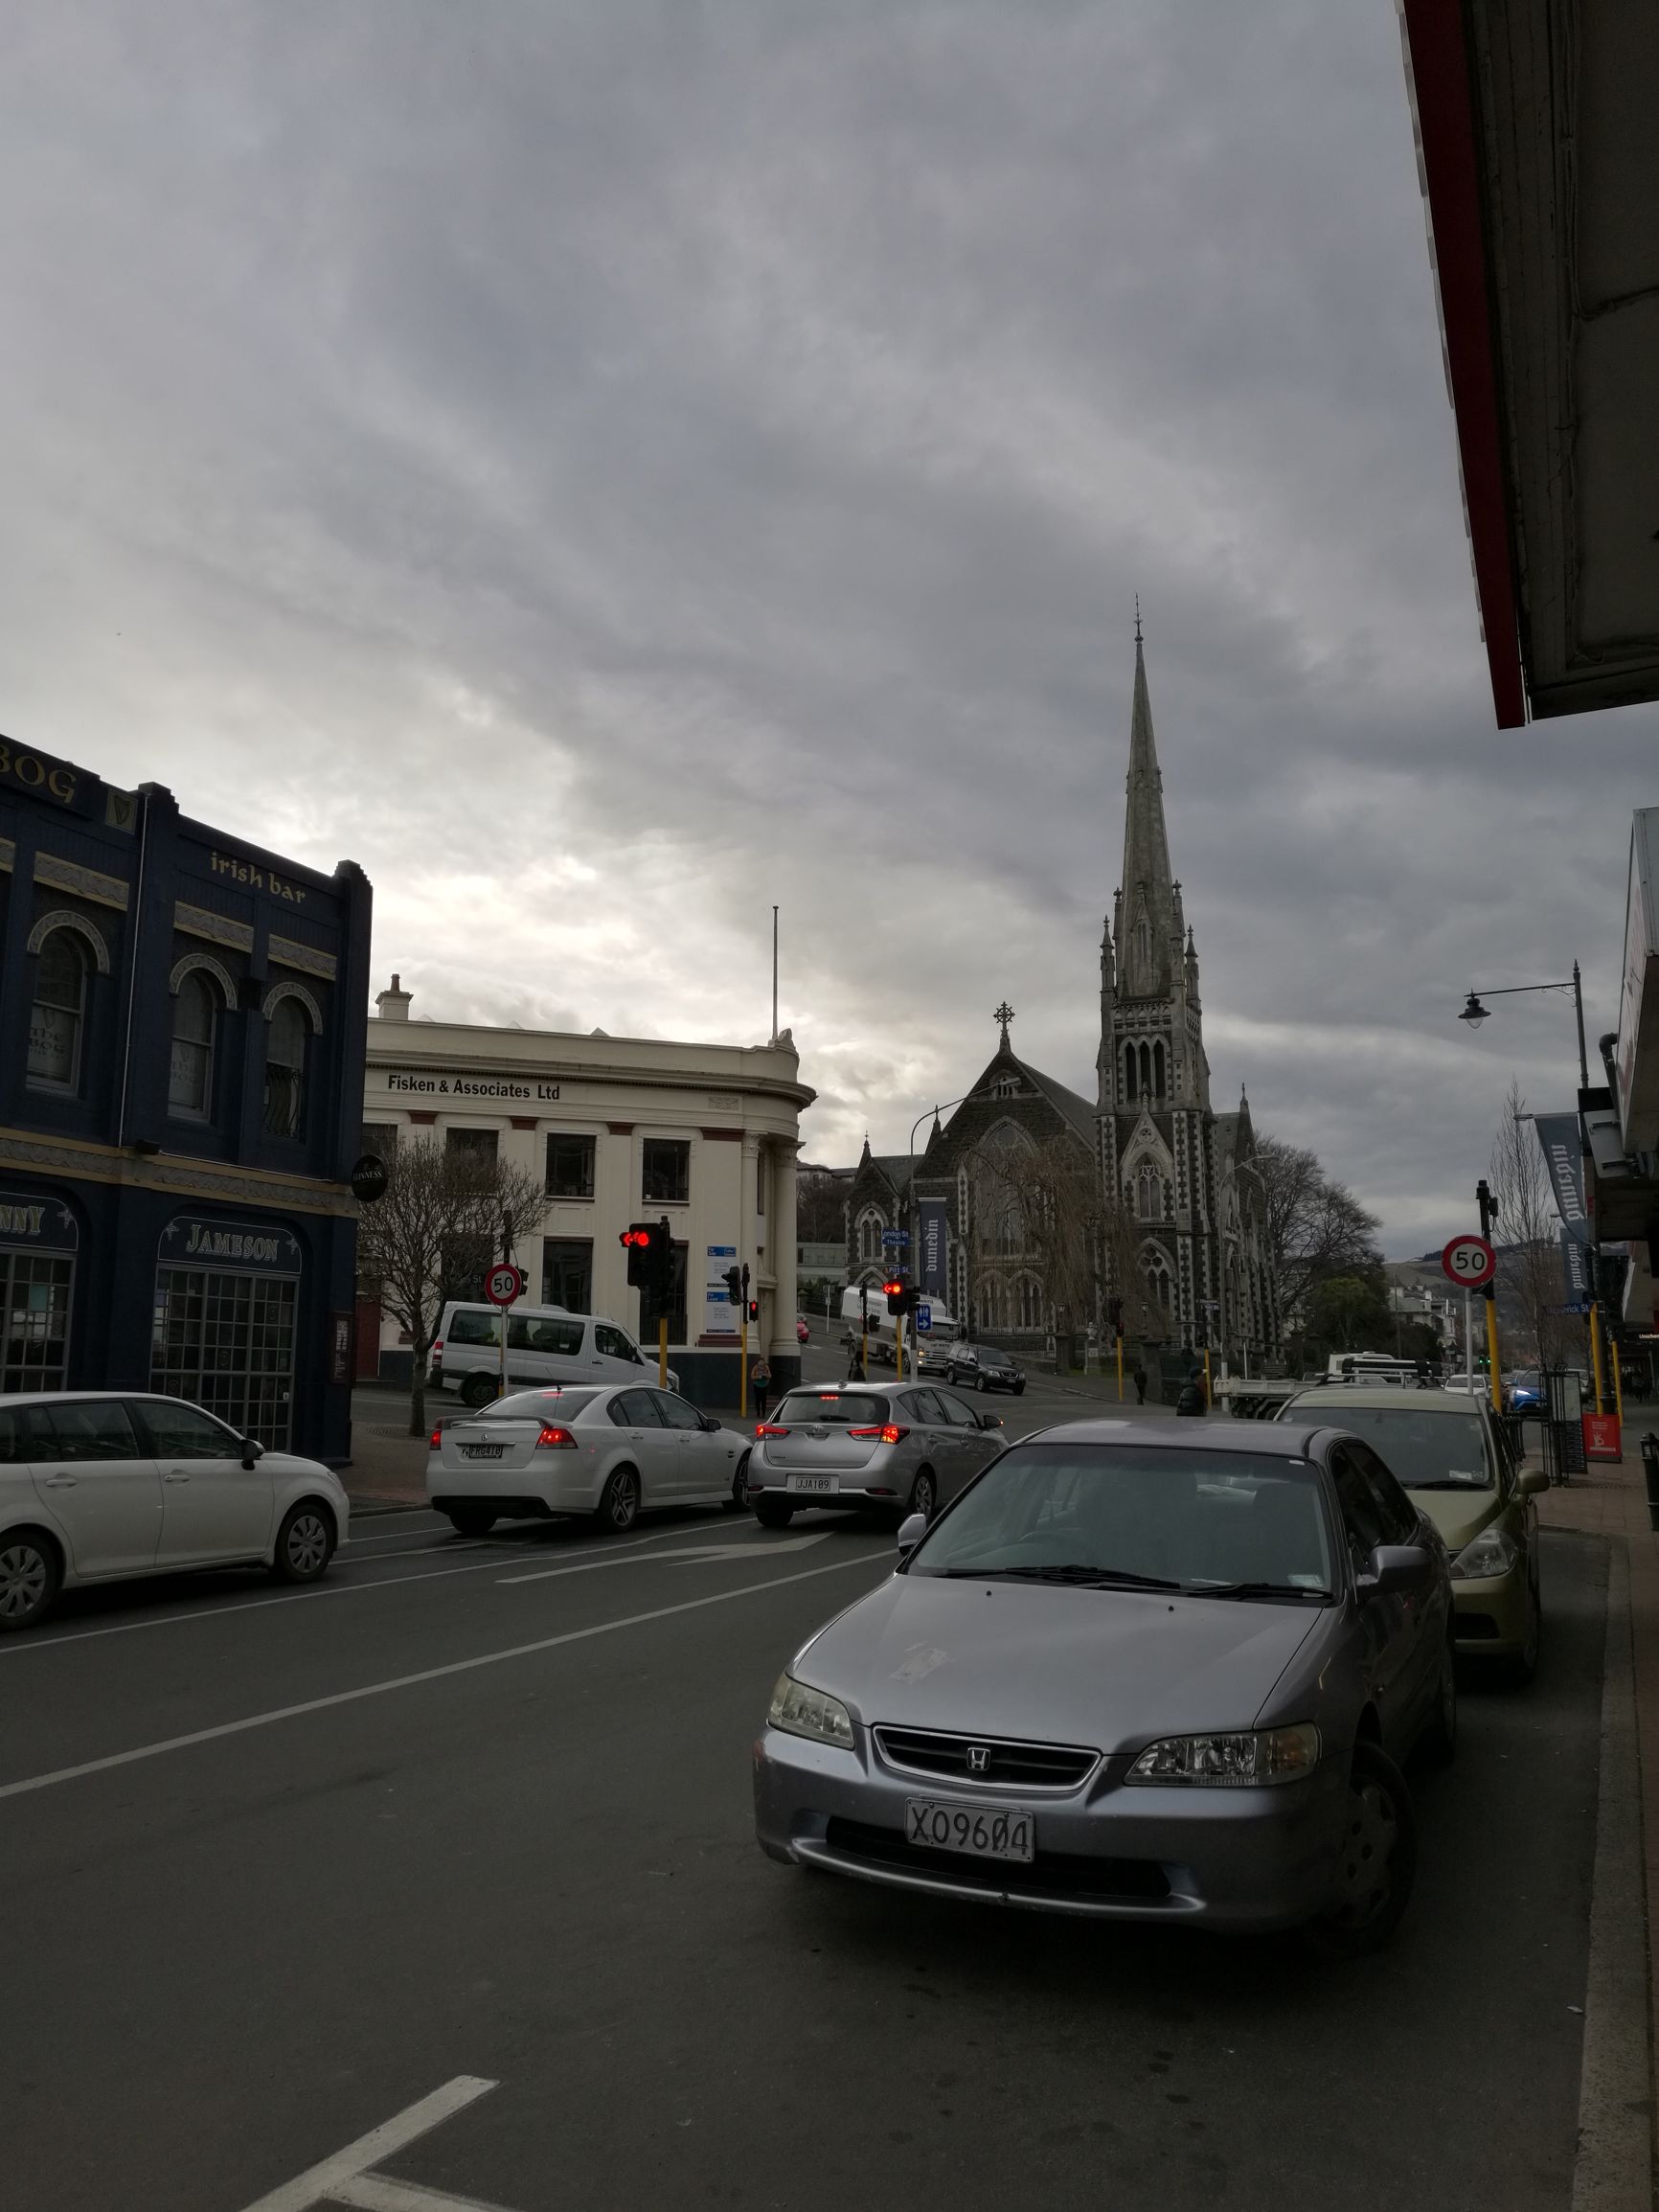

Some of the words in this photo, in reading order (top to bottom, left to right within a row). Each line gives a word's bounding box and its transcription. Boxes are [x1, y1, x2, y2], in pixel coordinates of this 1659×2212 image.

[211, 850, 261, 888] irish
[268, 873, 306, 903] bar
[388, 1074, 435, 1092] Fisken
[439, 1080, 448, 1093] &
[453, 1079, 530, 1098] Associates
[537, 1084, 560, 1100] Ltd
[186, 1223, 279, 1263] JAMESON
[924, 1219, 938, 1272] dunedin
[1456, 1251, 1486, 1270] 50
[494, 1276, 513, 1293] 50
[1580, 1304, 1589, 1312] St
